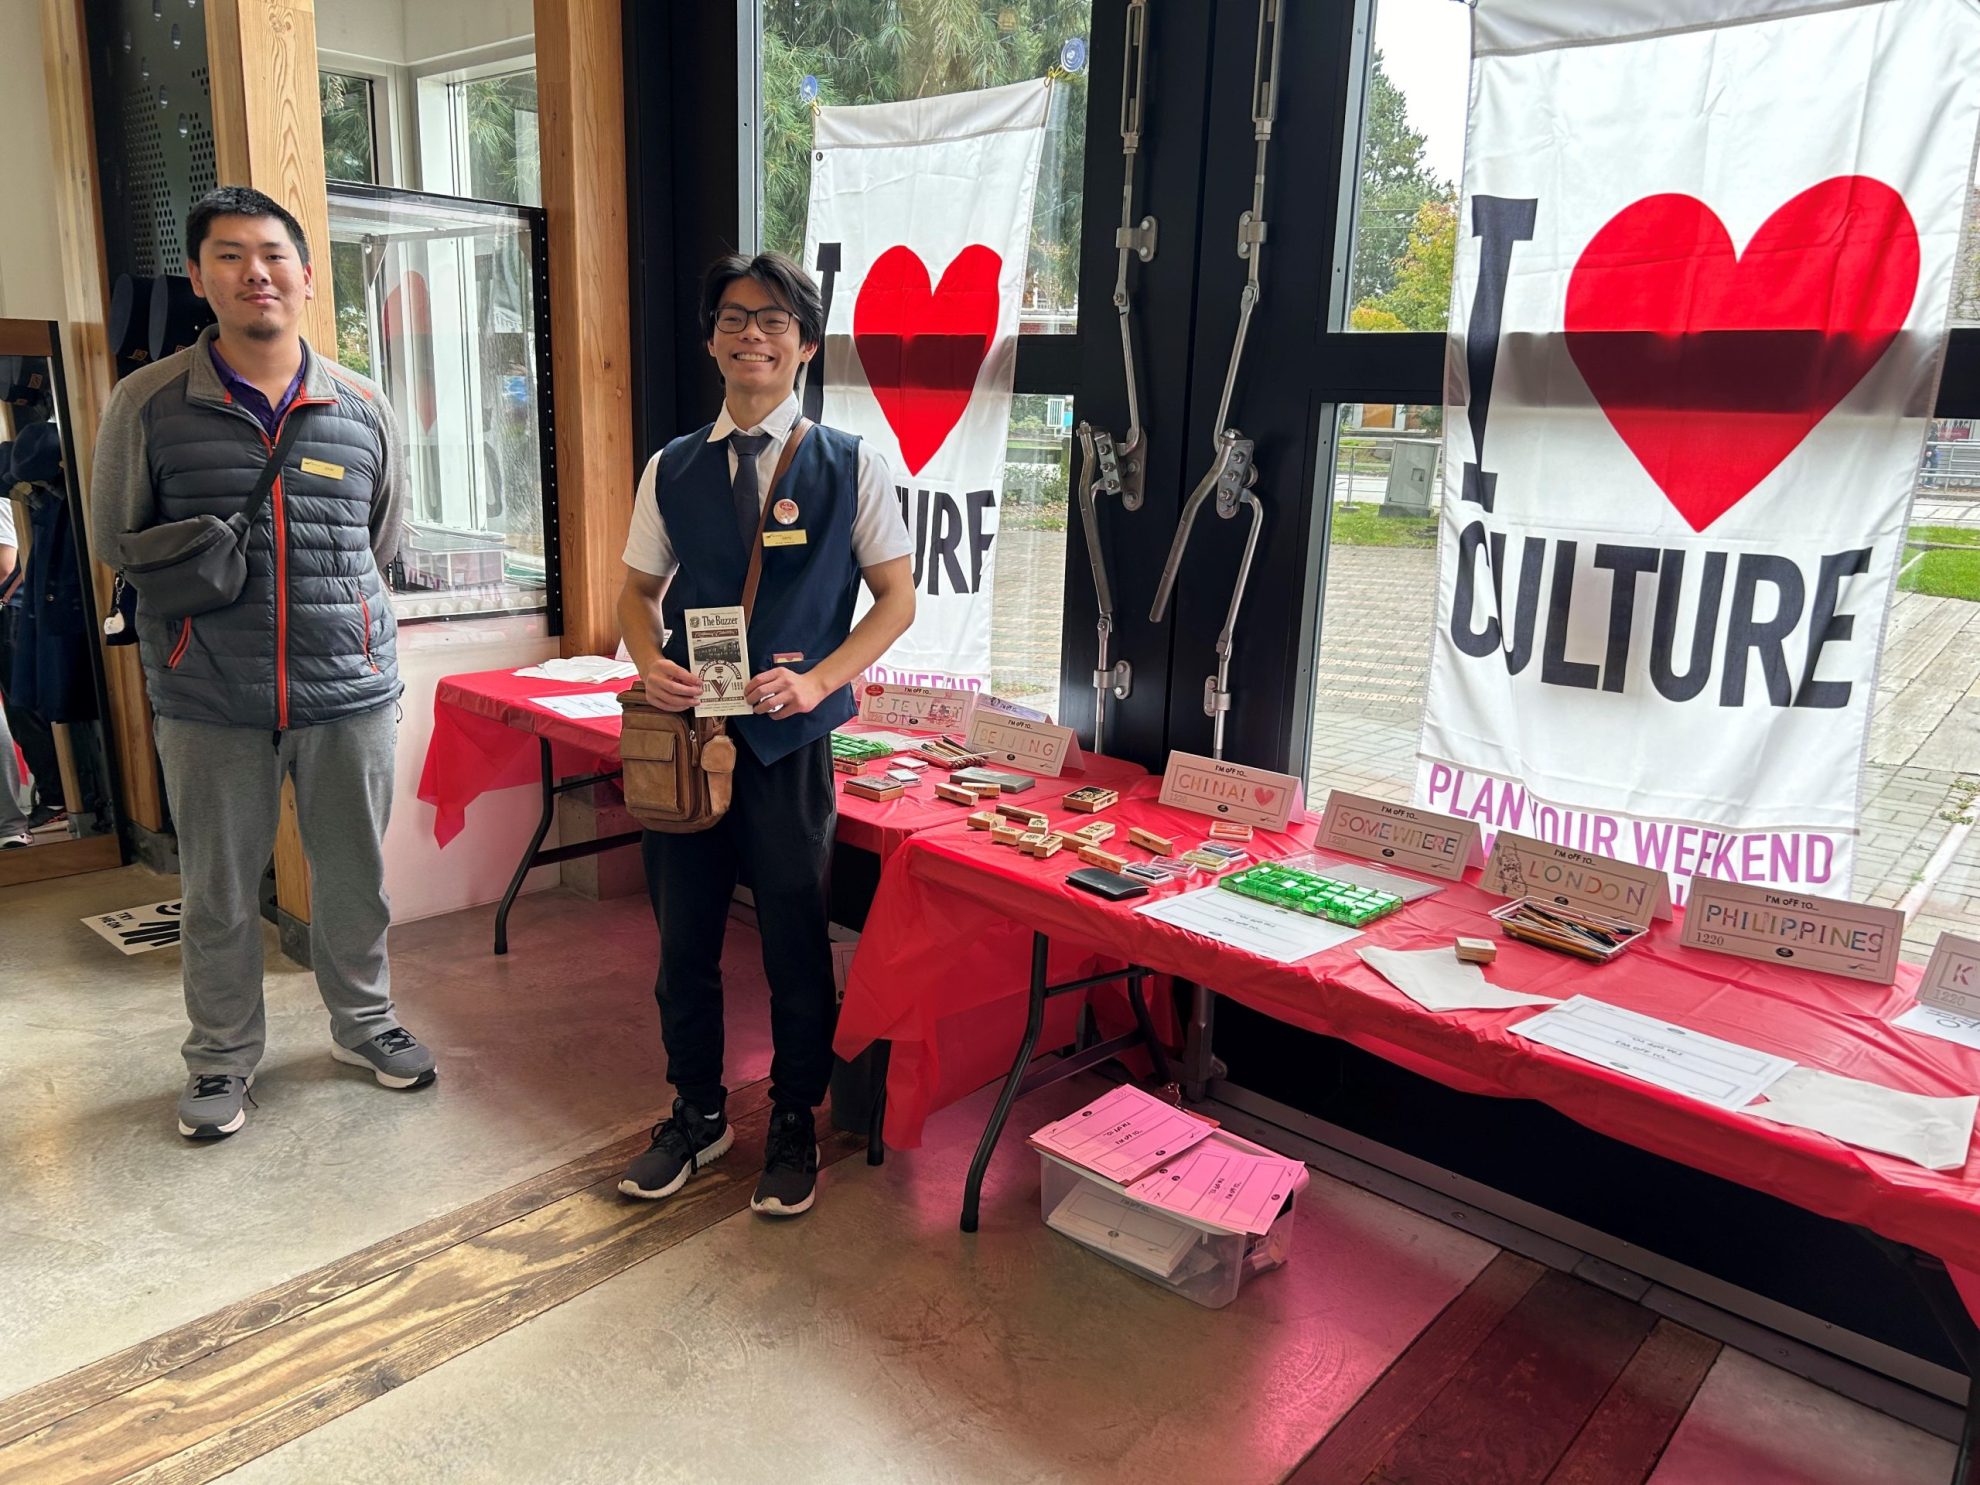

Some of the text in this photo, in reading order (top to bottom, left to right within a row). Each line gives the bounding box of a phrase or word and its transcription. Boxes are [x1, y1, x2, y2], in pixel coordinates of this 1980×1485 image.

[1462, 195, 1539, 513] I
[702, 615, 738, 626] The Buzzer
[1451, 520, 1873, 709] CULTURE
[980, 726, 1055, 757] BEIJING
[1178, 773, 1248, 803] CHINA!
[1429, 762, 1524, 831] PLAN
[1529, 796, 1618, 860] OUR
[1633, 819, 1834, 884] WEEKEND
[1528, 860, 1646, 906] LONDON
[1765, 894, 1781, 905] I'M
[1783, 897, 1799, 908] OFF
[1695, 931, 1725, 947] 1220
[1705, 904, 1884, 954] PHILIPPINES
[1935, 989, 1967, 1007] 1220
